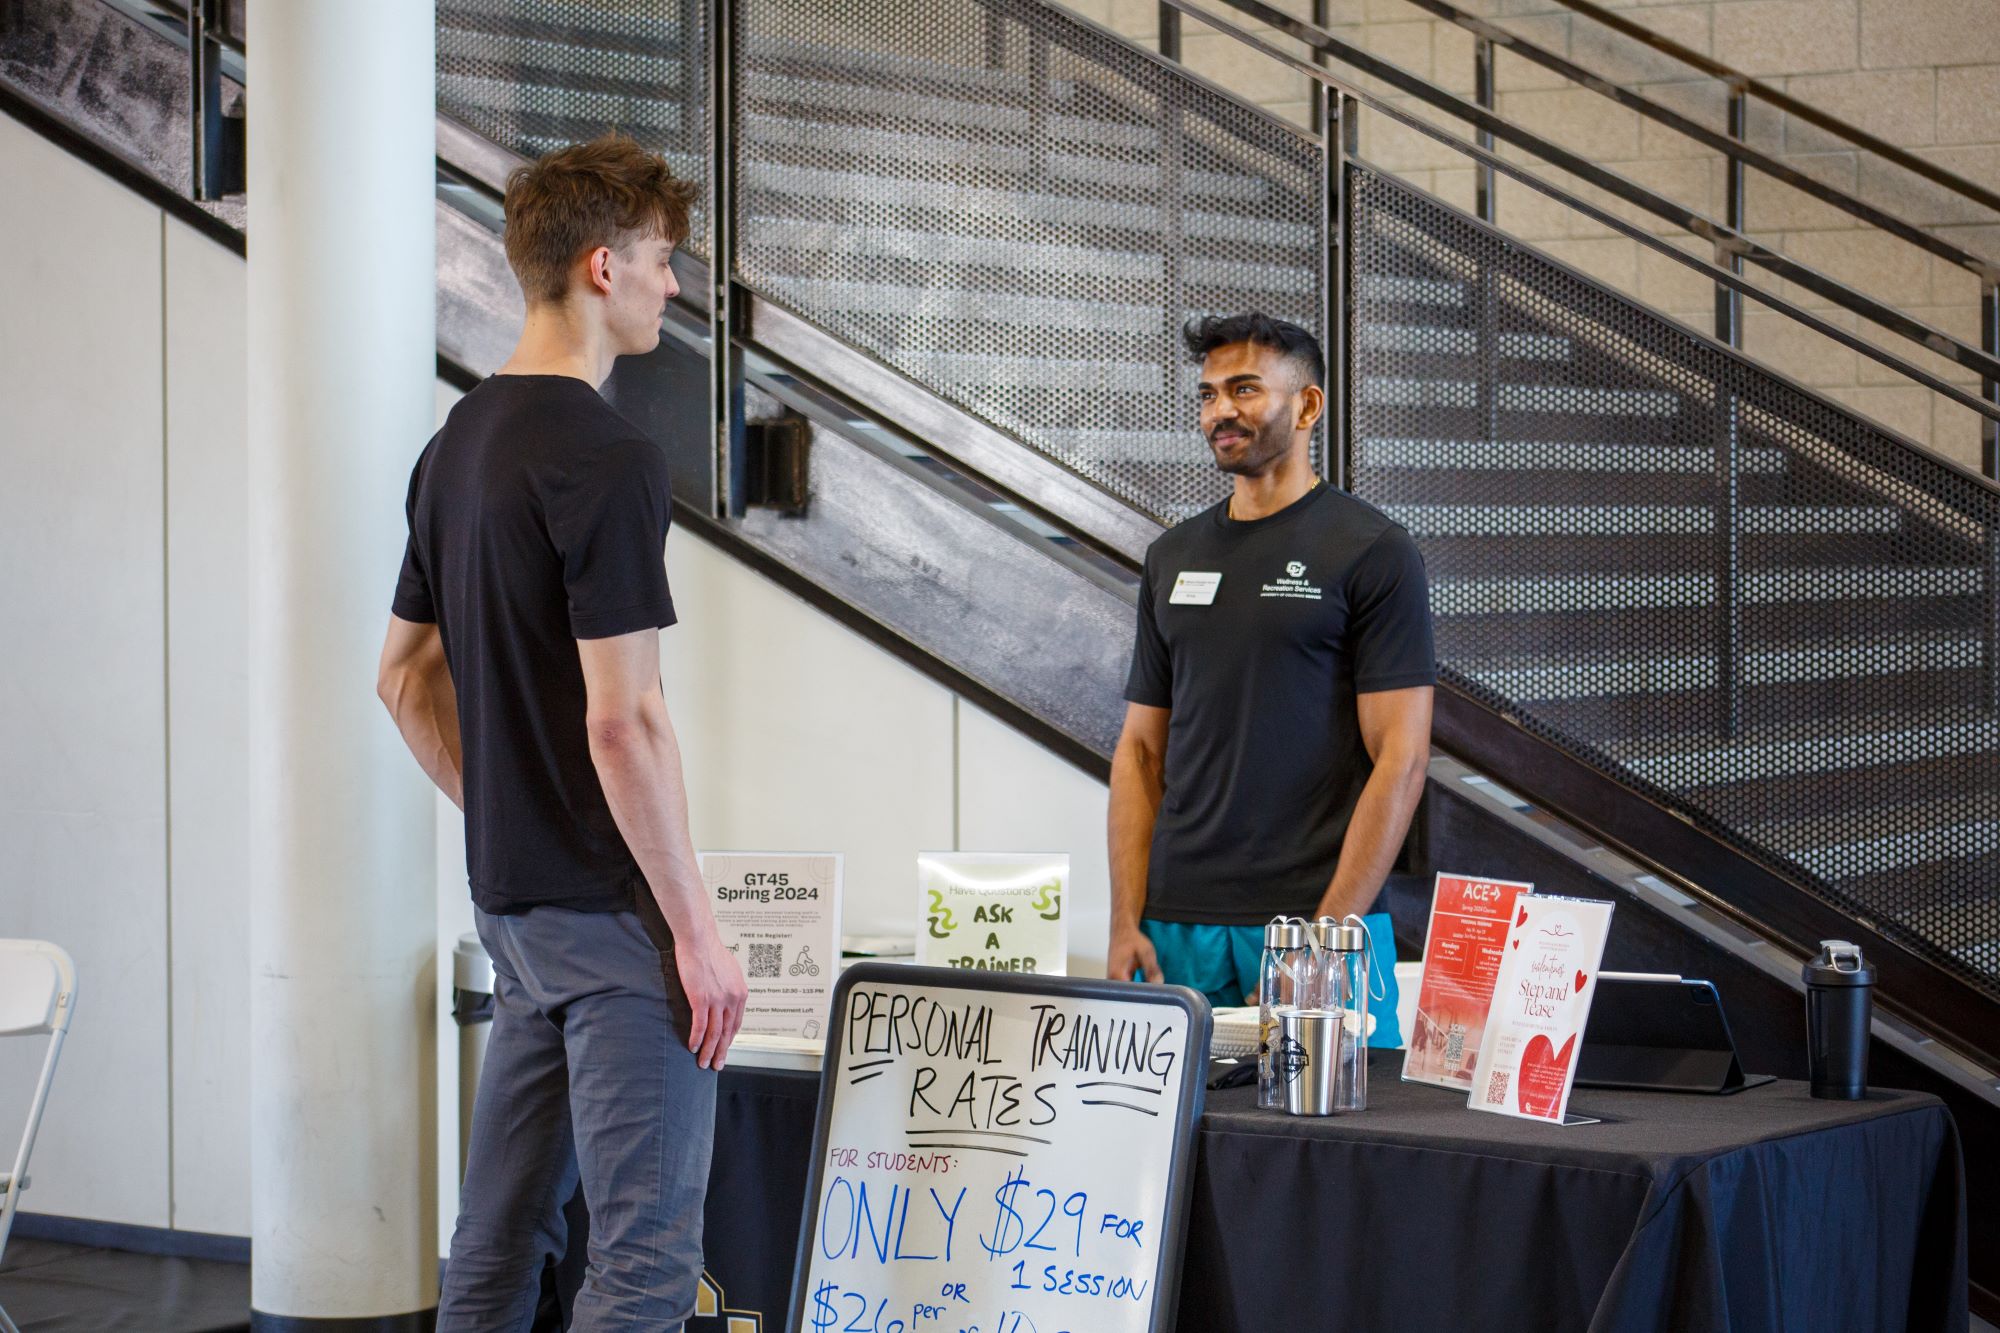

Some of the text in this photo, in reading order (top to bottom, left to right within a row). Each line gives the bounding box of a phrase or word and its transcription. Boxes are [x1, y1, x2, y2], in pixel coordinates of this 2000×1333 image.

[1262, 584, 1293, 592] Recreation
[744, 873, 789, 886] GT45
[717, 887, 819, 903] Spring 2024
[950, 886, 976, 896] Have
[1463, 882, 1490, 901] ACE
[973, 904, 1014, 923] ASK
[985, 932, 1000, 949] A
[1519, 980, 1544, 1003] Step
[1545, 982, 1569, 1001] and
[1524, 997, 1555, 1018] Tease
[850, 992, 1175, 1085] PERSONAL TRAINING
[910, 1067, 1056, 1129] RATES
[830, 1148, 958, 1173] FOR STUDENTS:
[822, 1164, 1144, 1264] ONLY $29 FOR
[1011, 1260, 1147, 1301] 1 SESSION
[941, 1282, 970, 1303] OR
[913, 1304, 948, 1329] per
